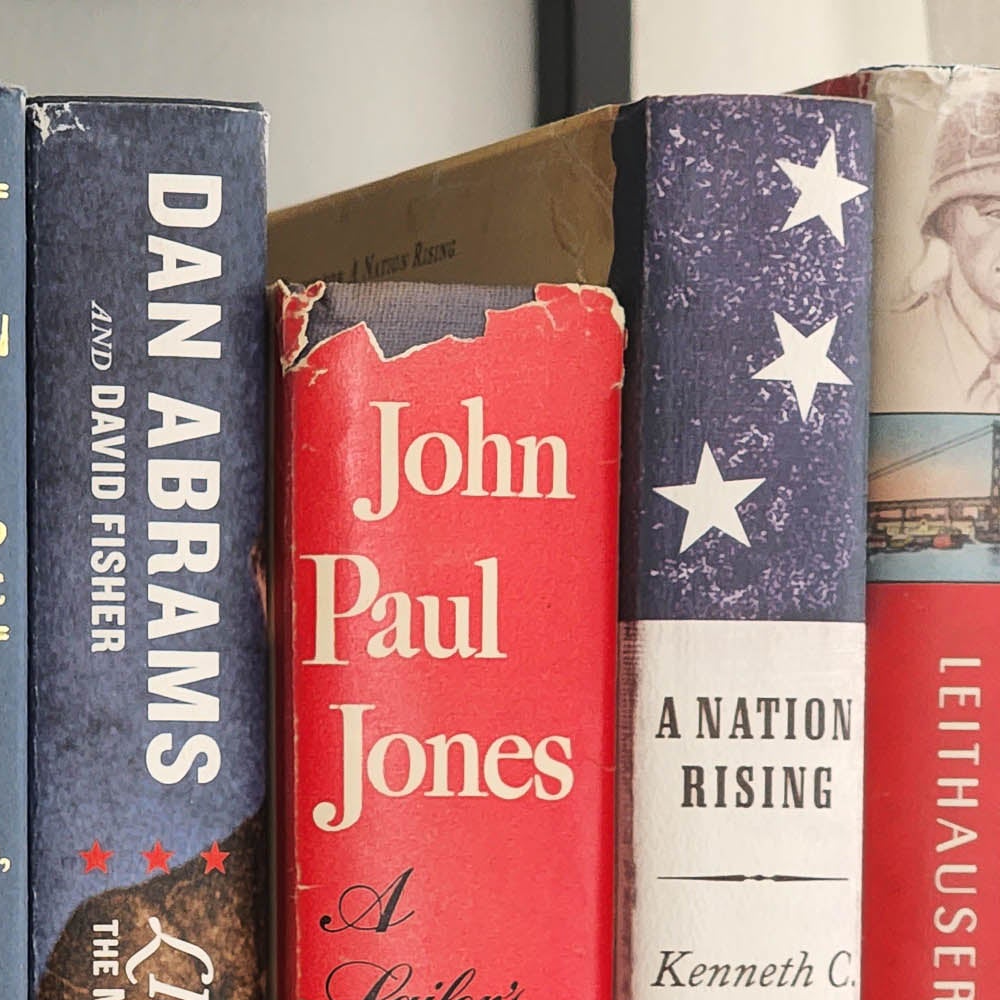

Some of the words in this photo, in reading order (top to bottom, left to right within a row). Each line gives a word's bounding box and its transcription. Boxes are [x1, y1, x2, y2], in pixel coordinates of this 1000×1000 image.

[148, 173, 222, 359] DAN
[91, 300, 113, 371] AND
[91, 385, 126, 500] DAVID
[352, 396, 576, 522] John
[90, 514, 126, 653] FISHER
[146, 391, 221, 785] ABRAMS
[300, 554, 508, 665] Paul
[312, 703, 574, 832] Jones
[655, 696, 681, 739] A
[696, 696, 853, 741] NATION
[681, 765, 833, 809] RISING
[92, 919, 119, 977] THE
[319, 867, 415, 933] A
[650, 949, 814, 988] Kenneth
[828, 949, 856, 988] C.
